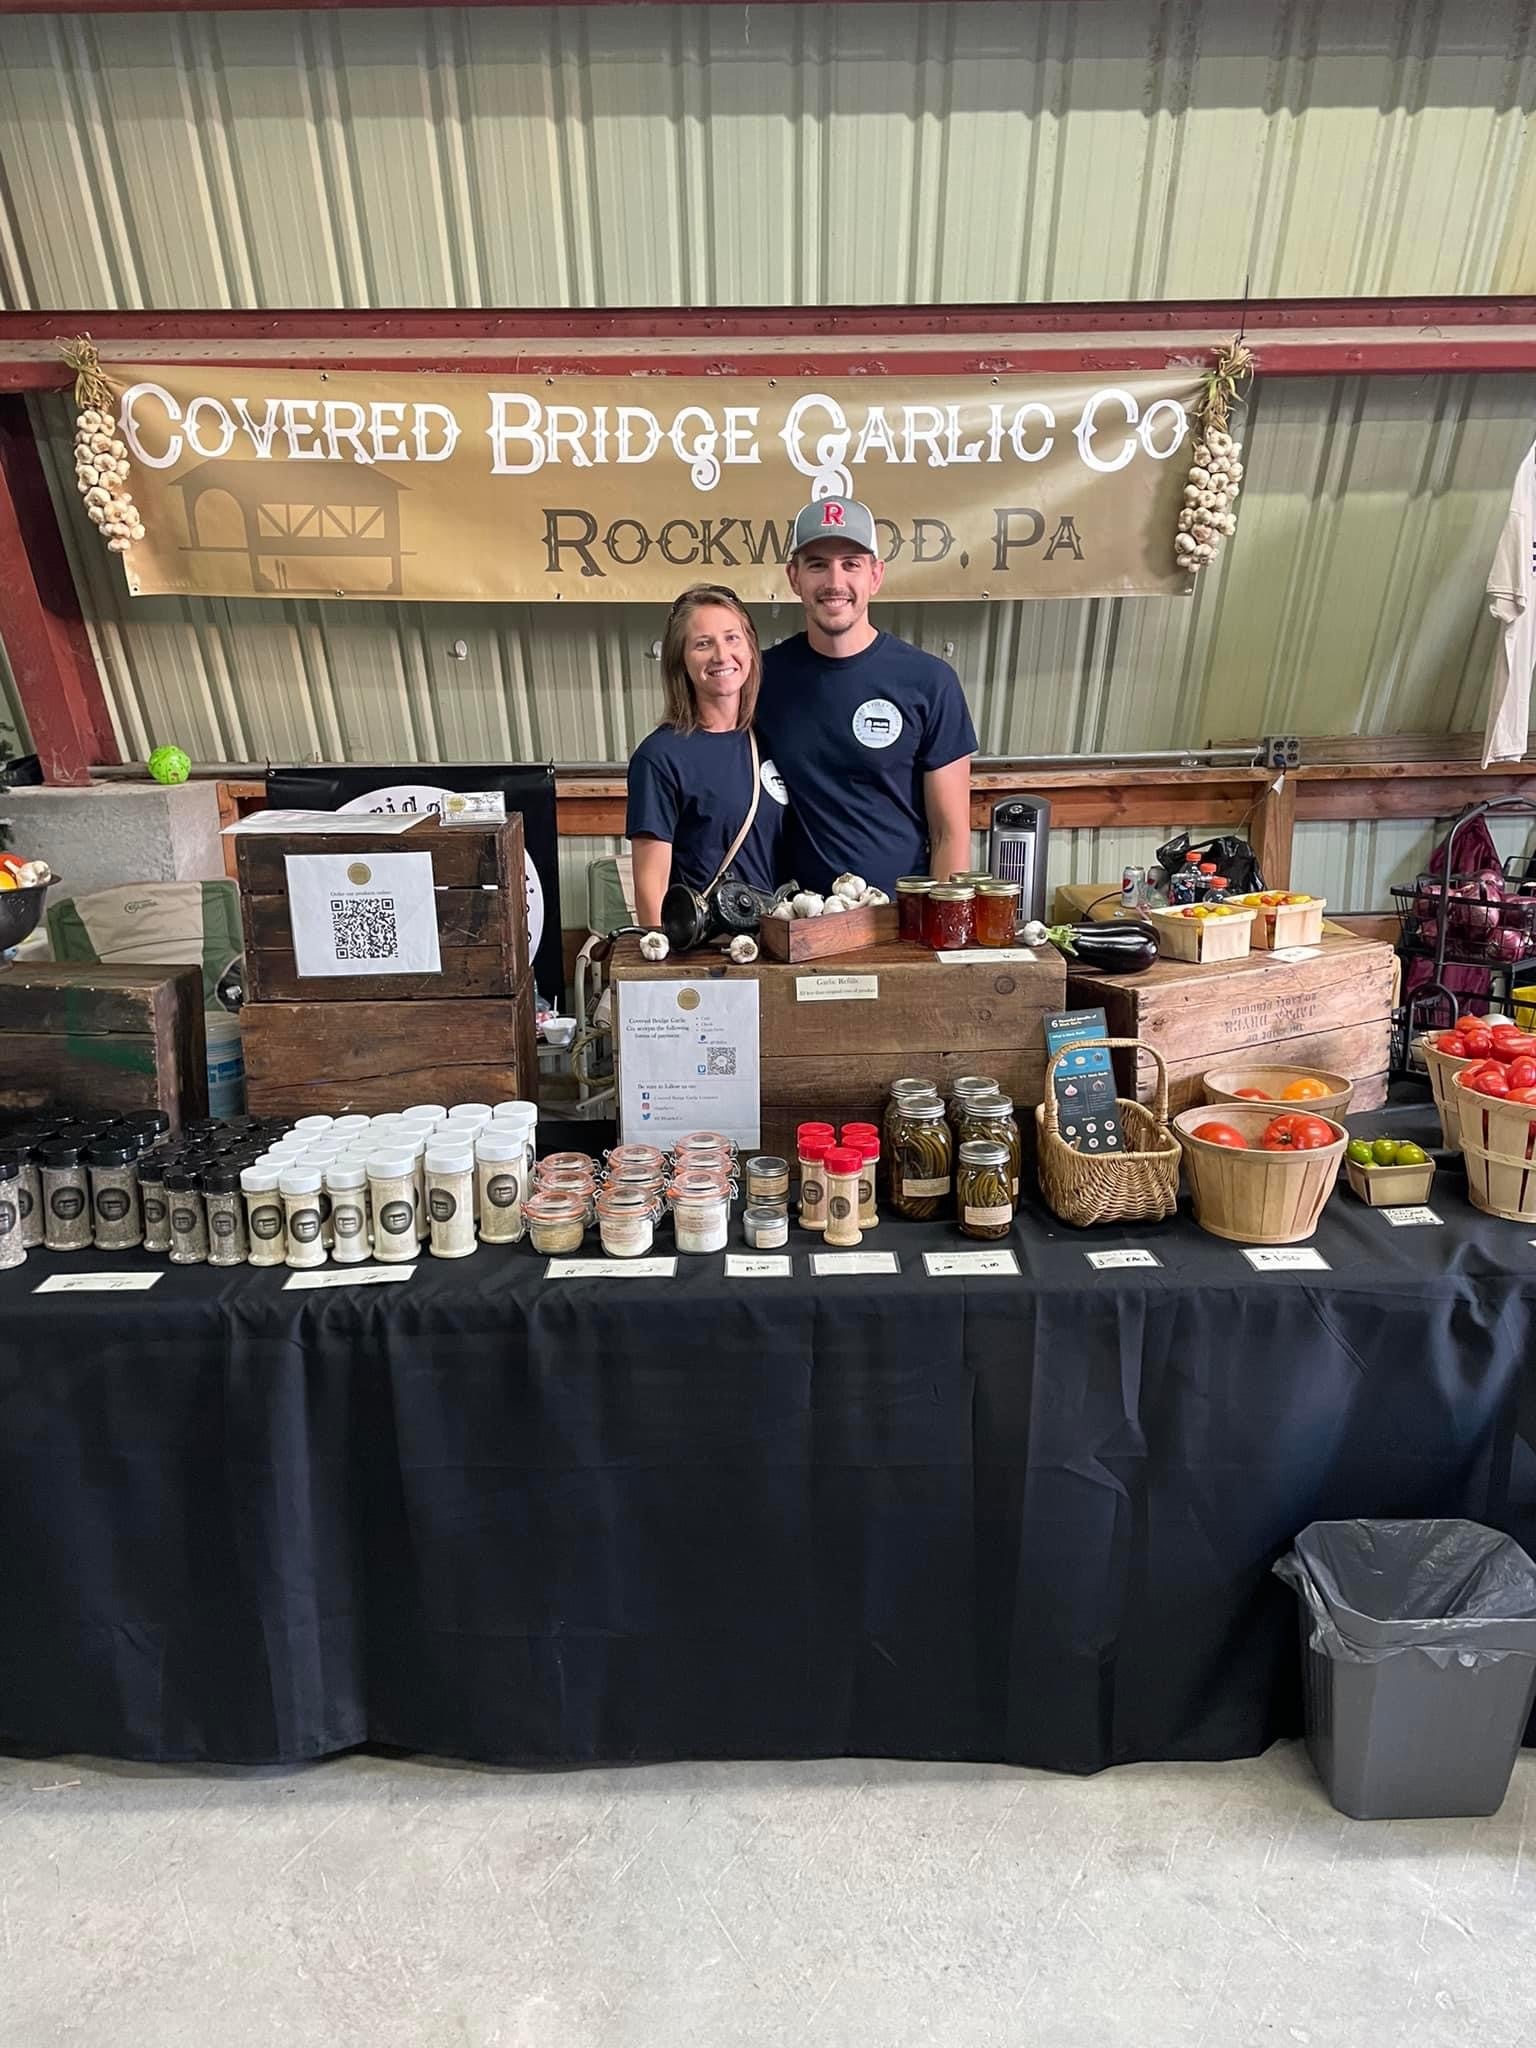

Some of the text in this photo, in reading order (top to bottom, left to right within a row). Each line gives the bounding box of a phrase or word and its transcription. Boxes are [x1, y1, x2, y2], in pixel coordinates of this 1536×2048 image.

[118, 383, 1189, 501] COVERED BRIDGE GARLIC CO
[821, 502, 846, 526] R
[991, 508, 1085, 571] PA
[1051, 1020, 1058, 1028] 6
